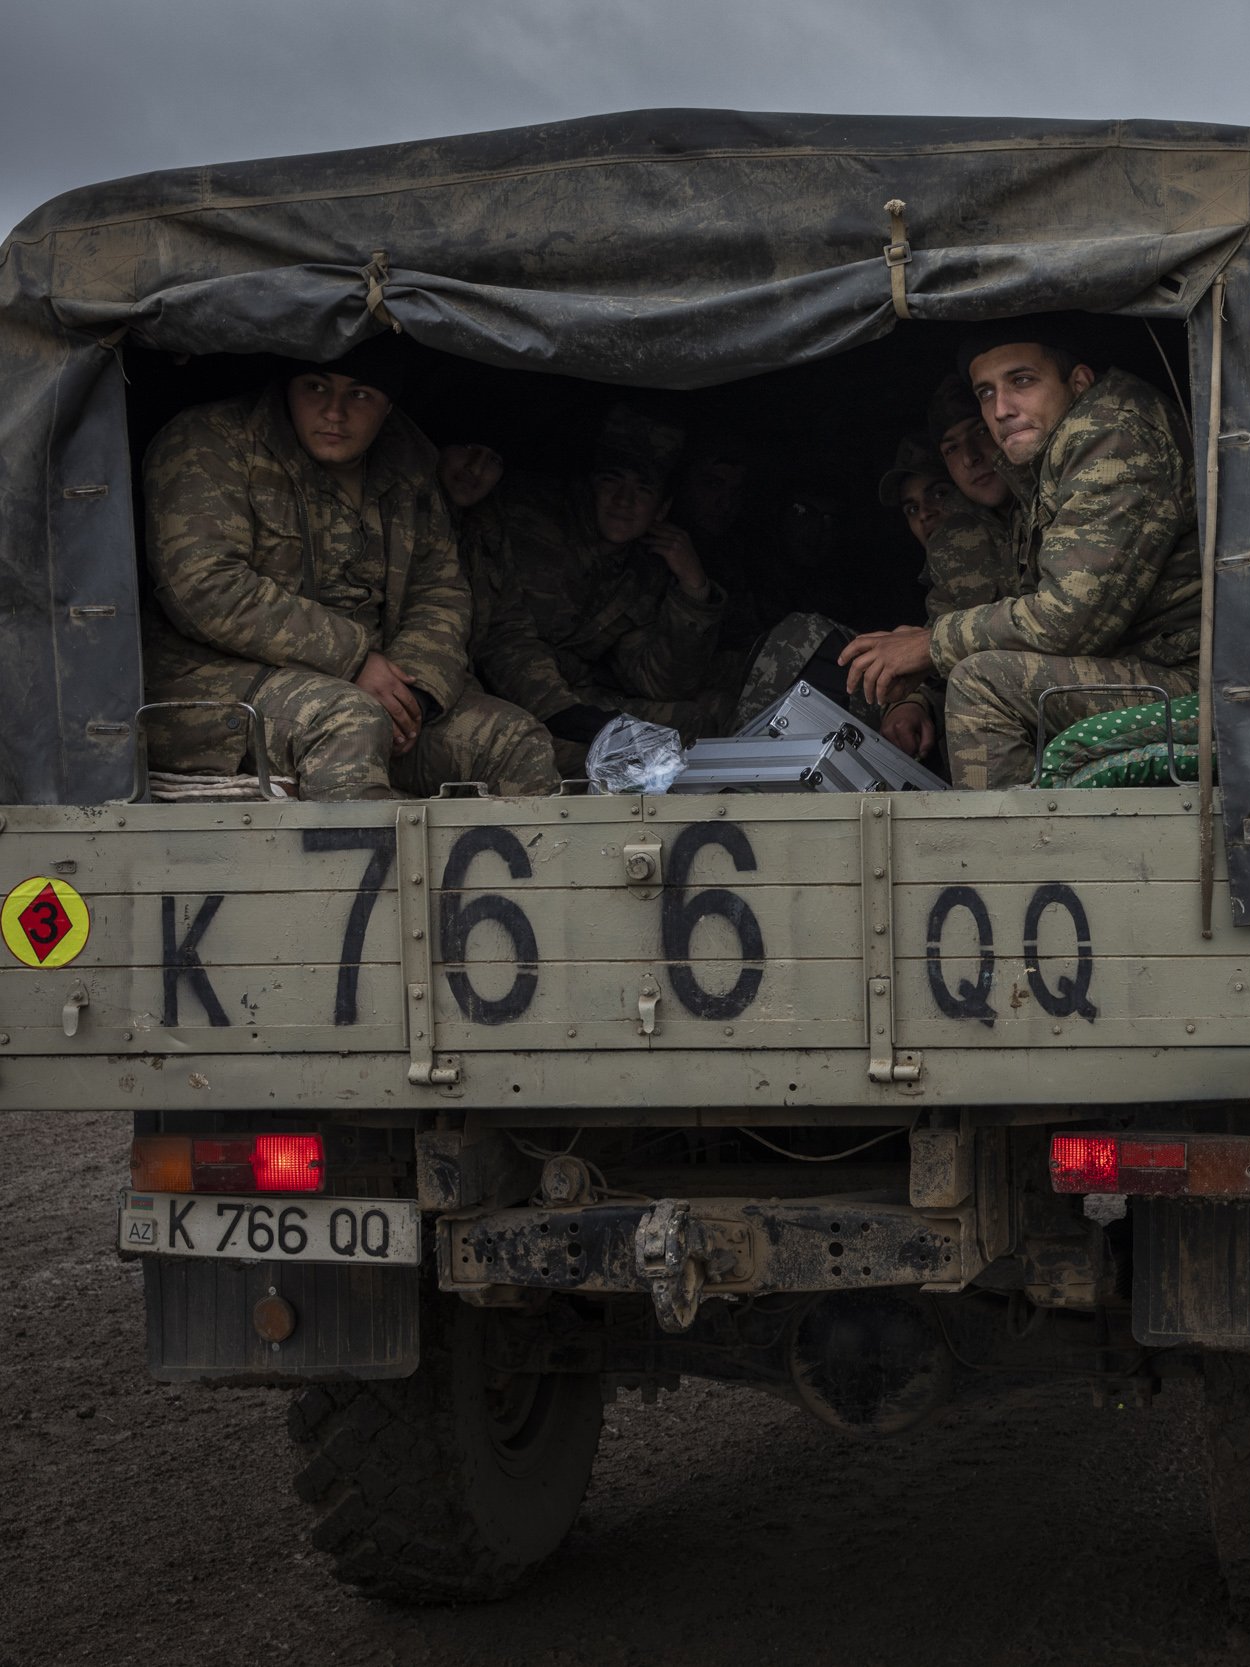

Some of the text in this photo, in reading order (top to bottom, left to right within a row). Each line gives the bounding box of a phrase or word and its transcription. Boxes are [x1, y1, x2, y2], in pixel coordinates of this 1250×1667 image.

[30, 902, 57, 943] 3
[163, 896, 230, 1028] K
[926, 884, 1097, 1027] QQ
[129, 1222, 151, 1240] AZ
[169, 1200, 389, 1258] K 766 QQ
